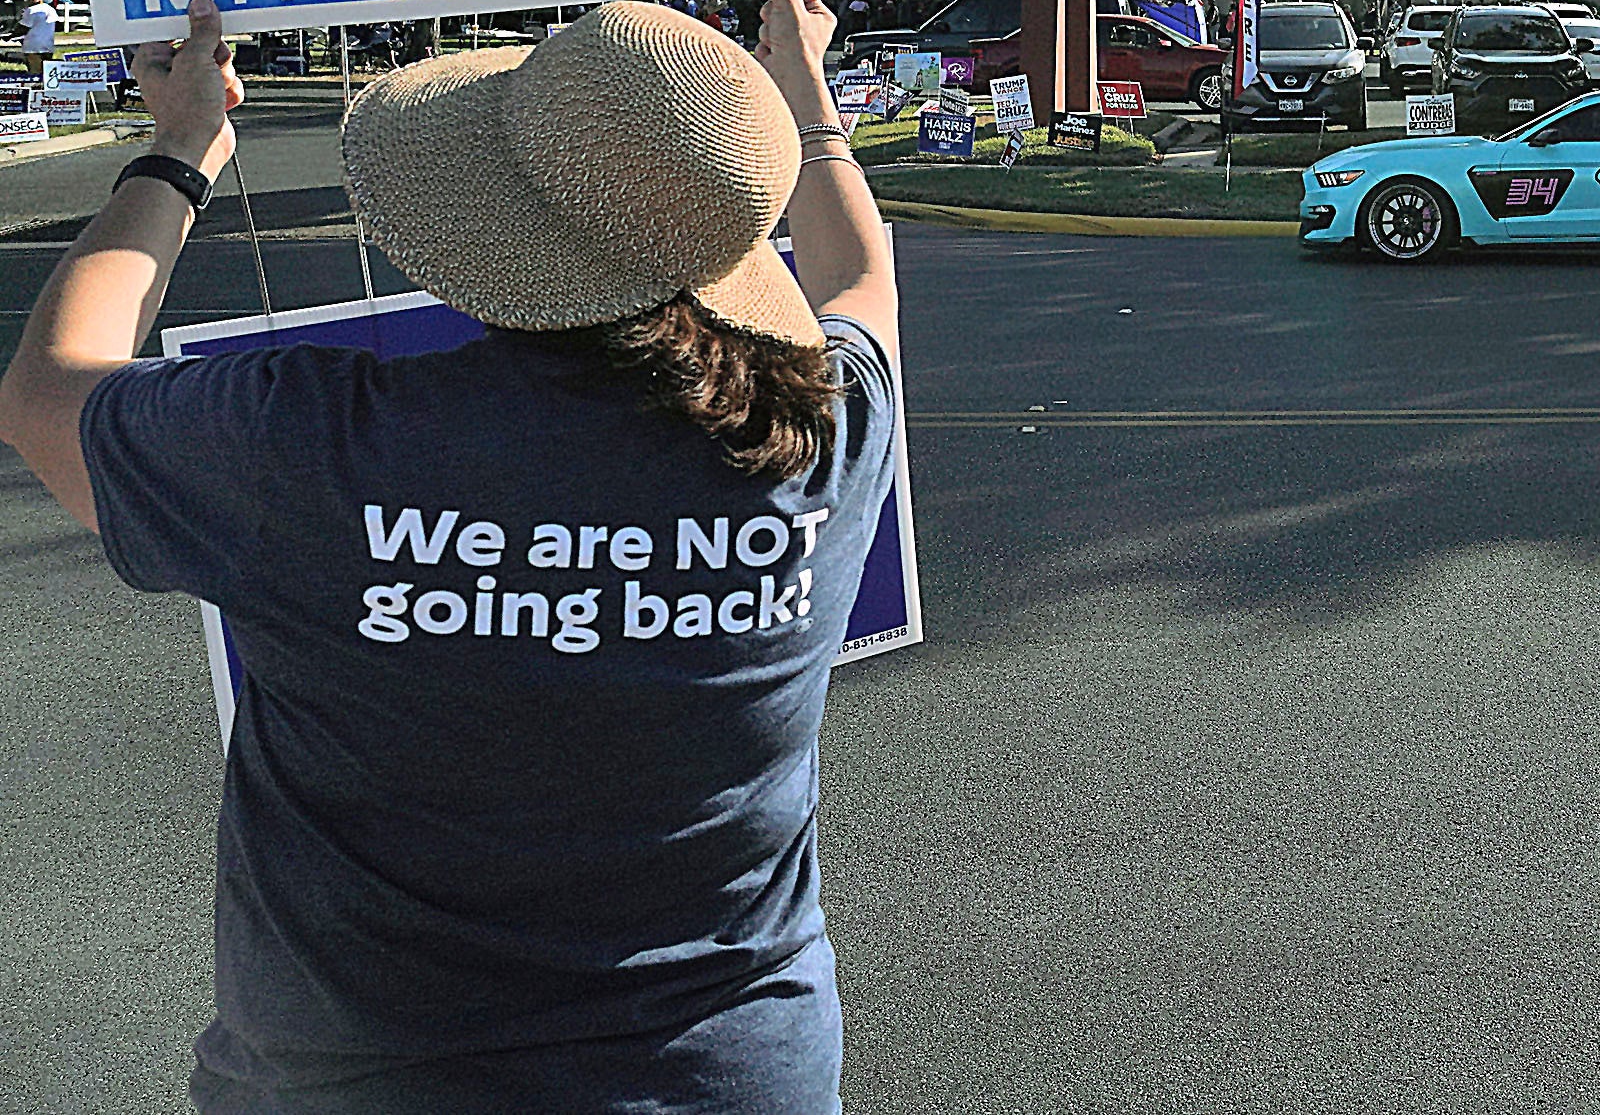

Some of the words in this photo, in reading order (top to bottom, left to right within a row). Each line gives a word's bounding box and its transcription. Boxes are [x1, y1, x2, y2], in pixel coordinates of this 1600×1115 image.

[992, 78, 1026, 91] TRUMP
[996, 100, 1011, 109] TED
[1104, 93, 1137, 103] CRUZ
[997, 104, 1029, 119] CRUZ
[924, 118, 972, 133] HARRIS
[1063, 114, 1088, 127] Joe
[1415, 121, 1453, 131] JUDGE
[928, 129, 964, 144] WALZ
[1054, 122, 1096, 136] Martinez
[1053, 133, 1095, 148] Justice
[1506, 178, 1559, 205] 34
[364, 504, 507, 567] We
[527, 522, 655, 572] are
[676, 507, 830, 570] NOT
[357, 575, 602, 654] going
[624, 568, 813, 642] back!
